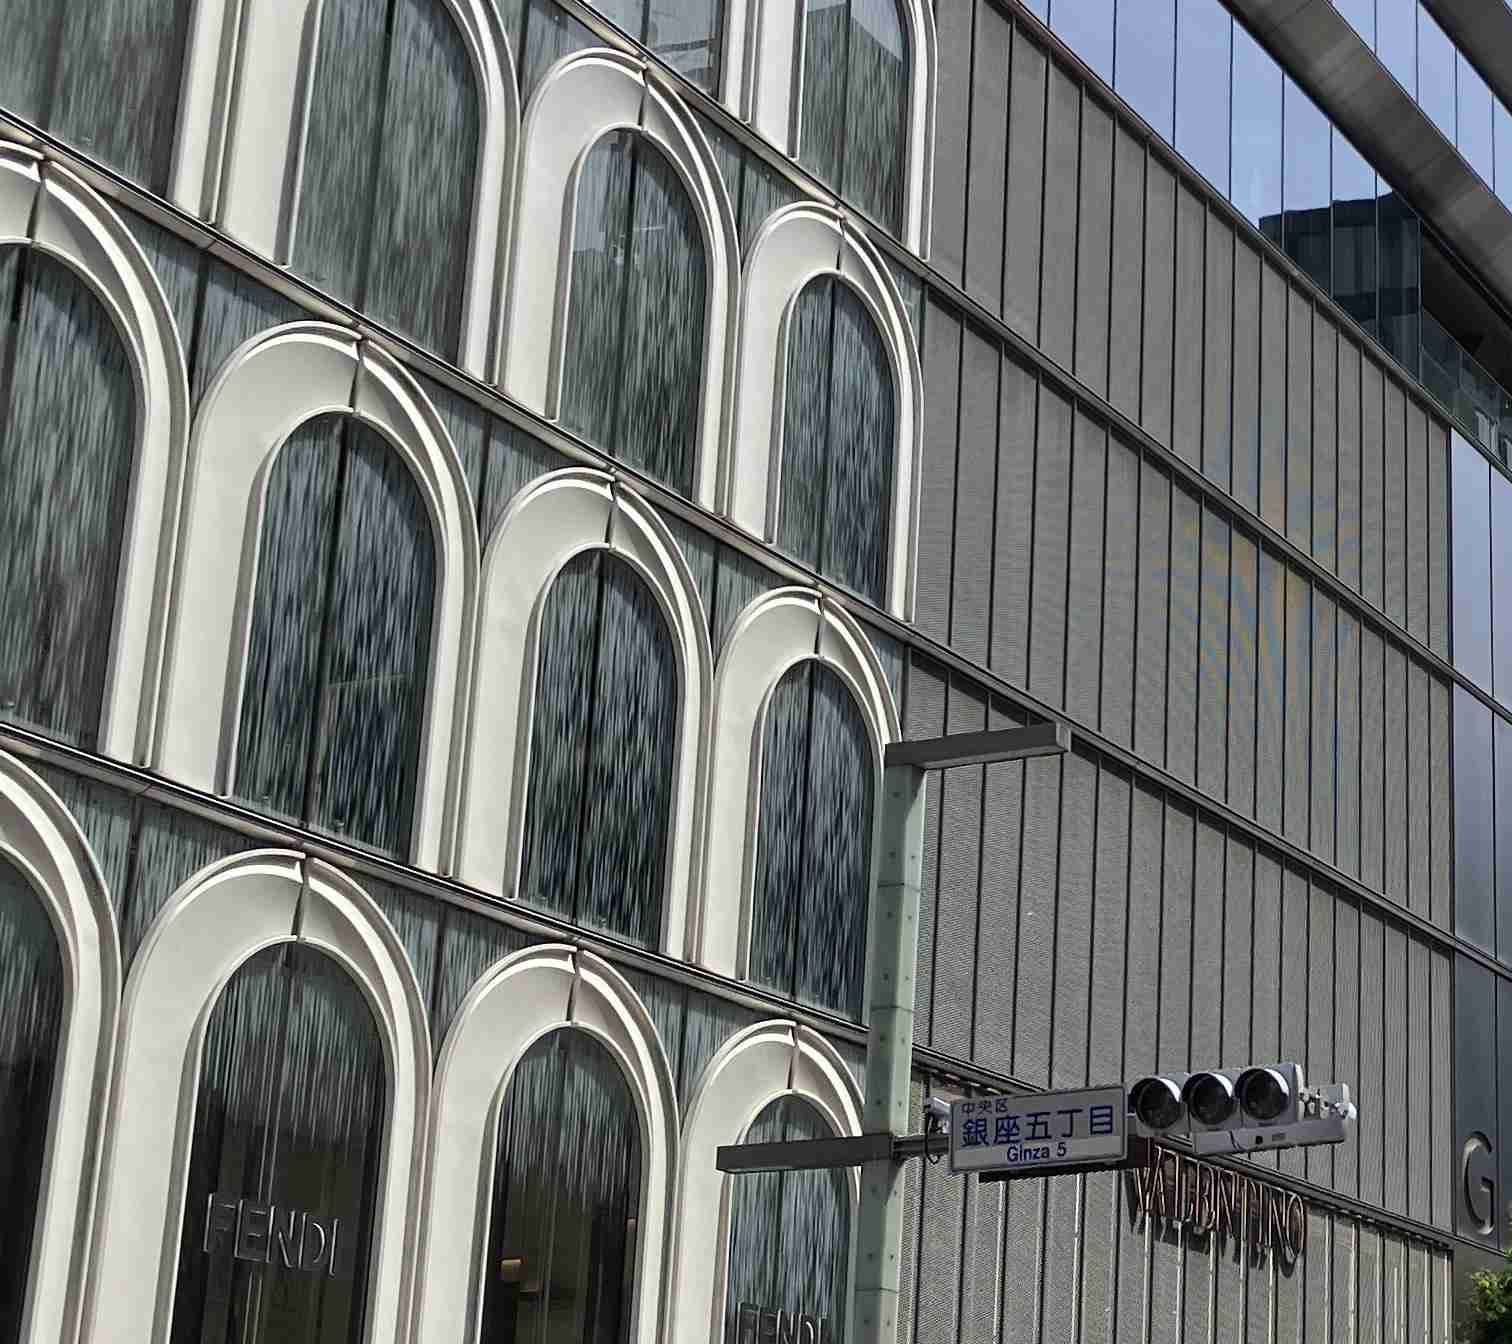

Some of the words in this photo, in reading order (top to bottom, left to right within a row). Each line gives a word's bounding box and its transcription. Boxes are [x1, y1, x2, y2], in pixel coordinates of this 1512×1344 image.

[961, 1098, 1008, 1115] 中央区
[961, 1105, 1114, 1148] 銀座五丁目
[1006, 1145, 1050, 1163] Ginza
[1057, 1142, 1067, 1157] 5
[202, 1192, 340, 1279] FENDI
